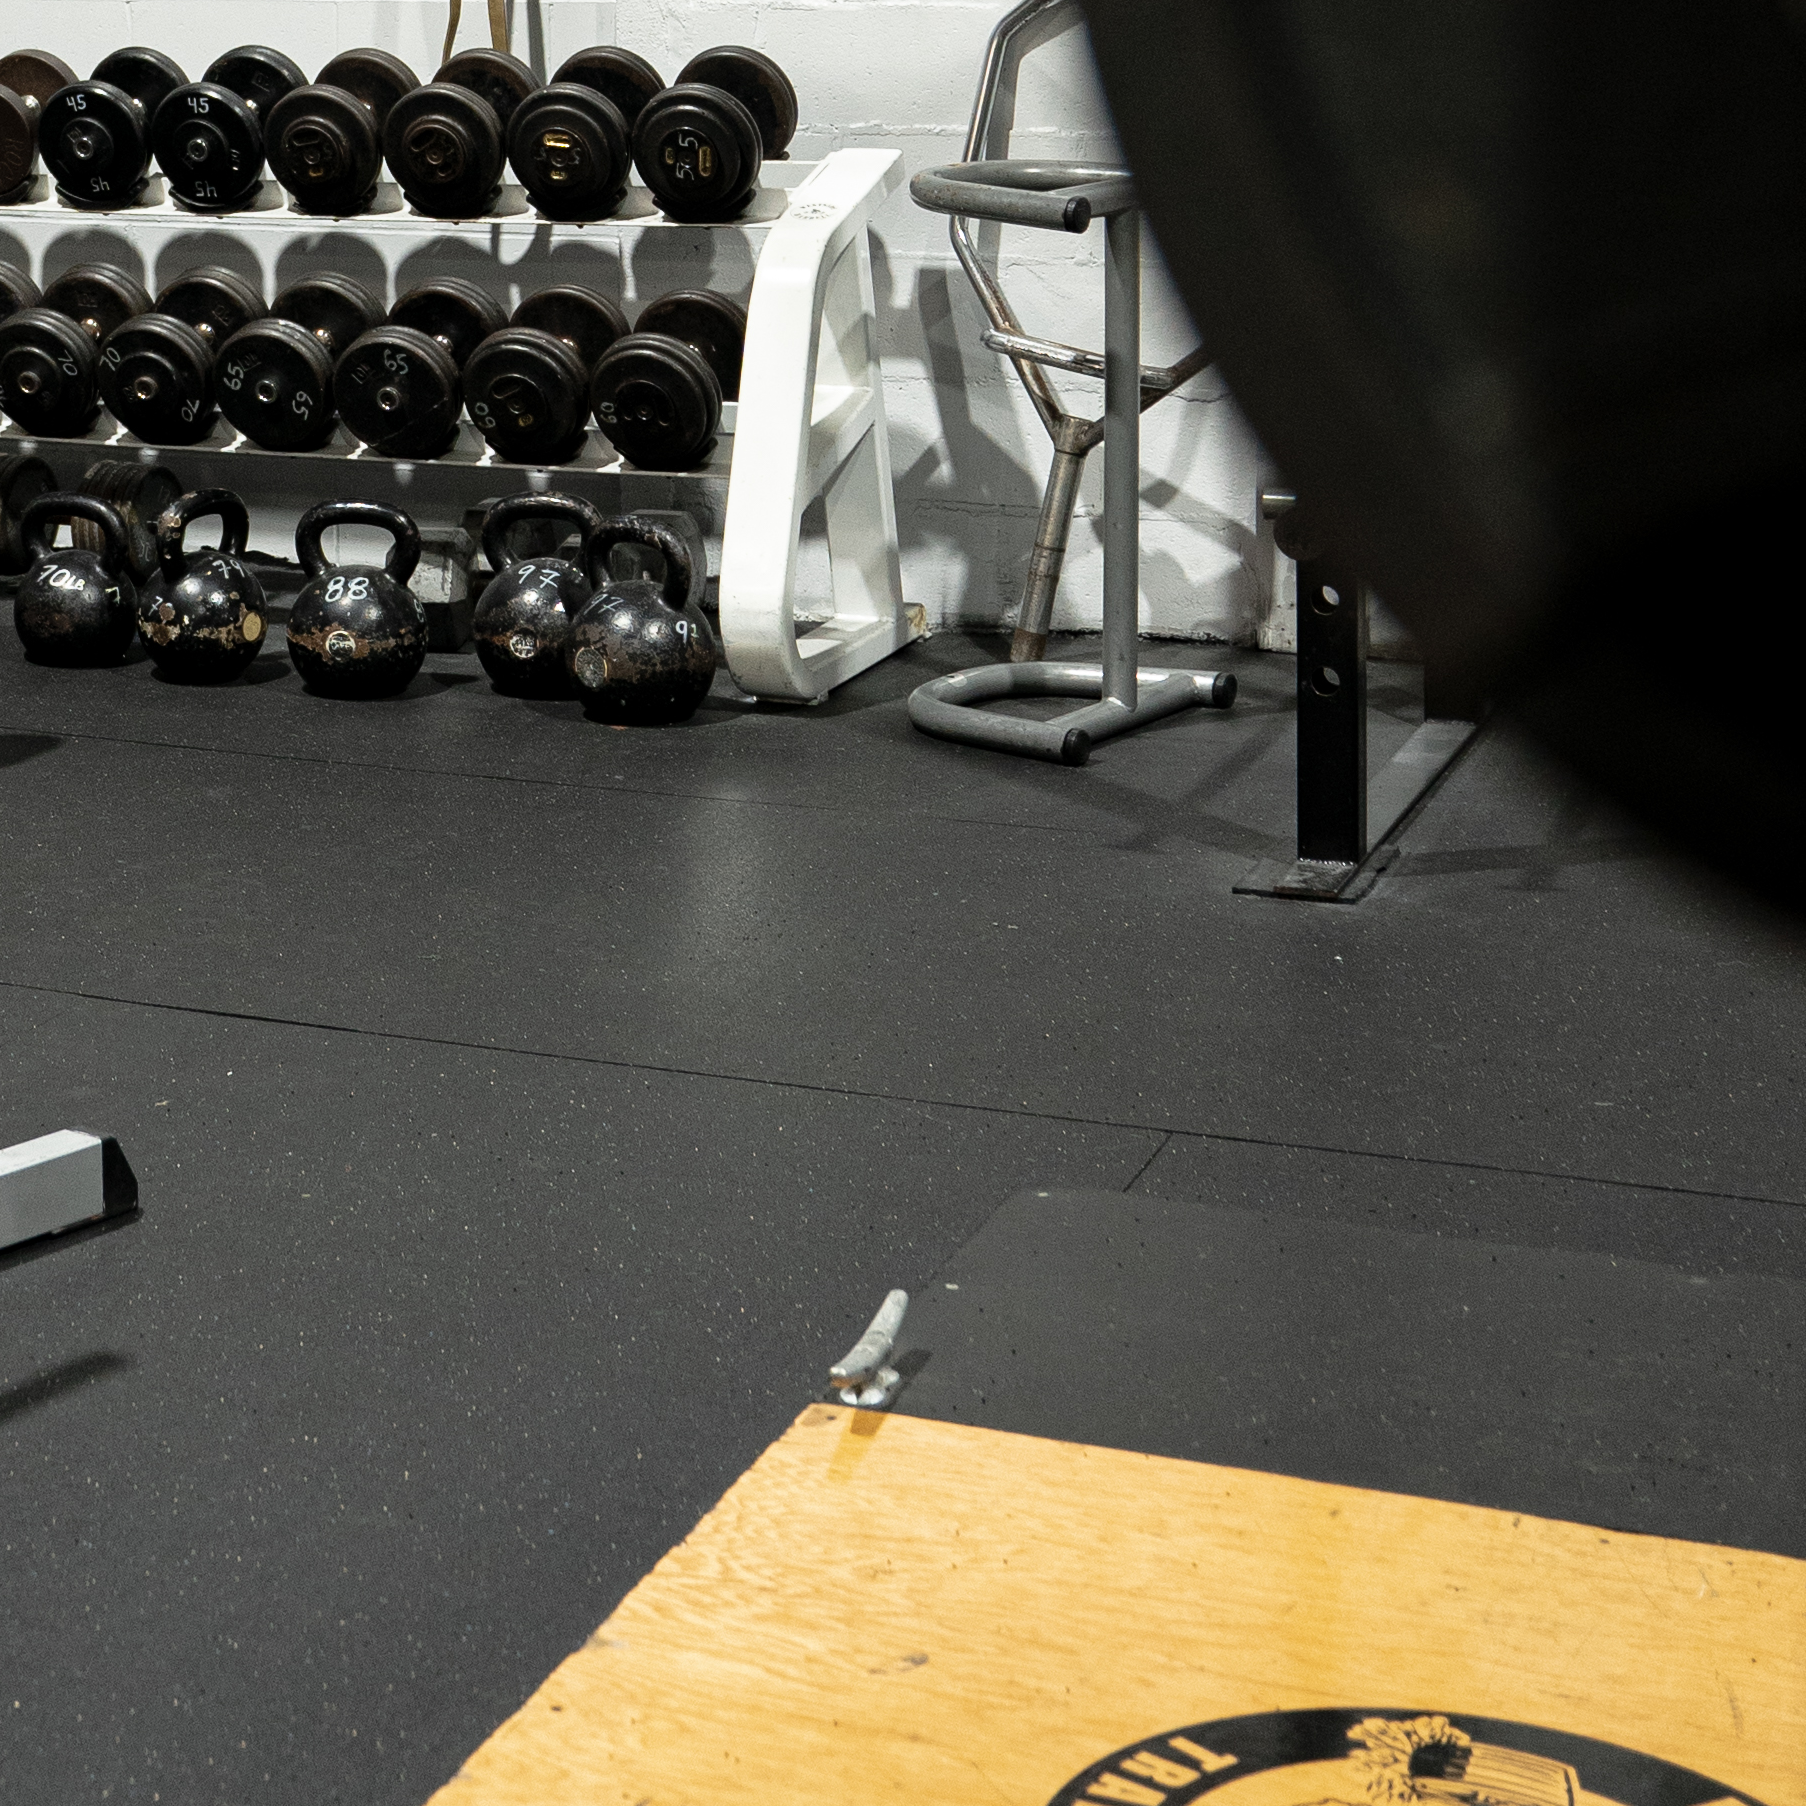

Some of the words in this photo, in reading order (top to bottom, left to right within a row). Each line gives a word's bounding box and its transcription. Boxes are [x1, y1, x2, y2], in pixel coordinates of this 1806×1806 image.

[65, 94, 87, 113] 45
[187, 96, 211, 114] 45
[90, 175, 111, 193] 45
[194, 180, 218, 198] 45
[57, 348, 78, 377] 70
[98, 346, 122, 372] 70
[382, 348, 410, 375] 65
[223, 361, 245, 391] 65
[180, 398, 201, 422] 70
[292, 390, 314, 421] 65
[324, 575, 370, 603] 88
[517, 564, 562, 590] 97
[1071, 1735, 1240, 1806] TRA
